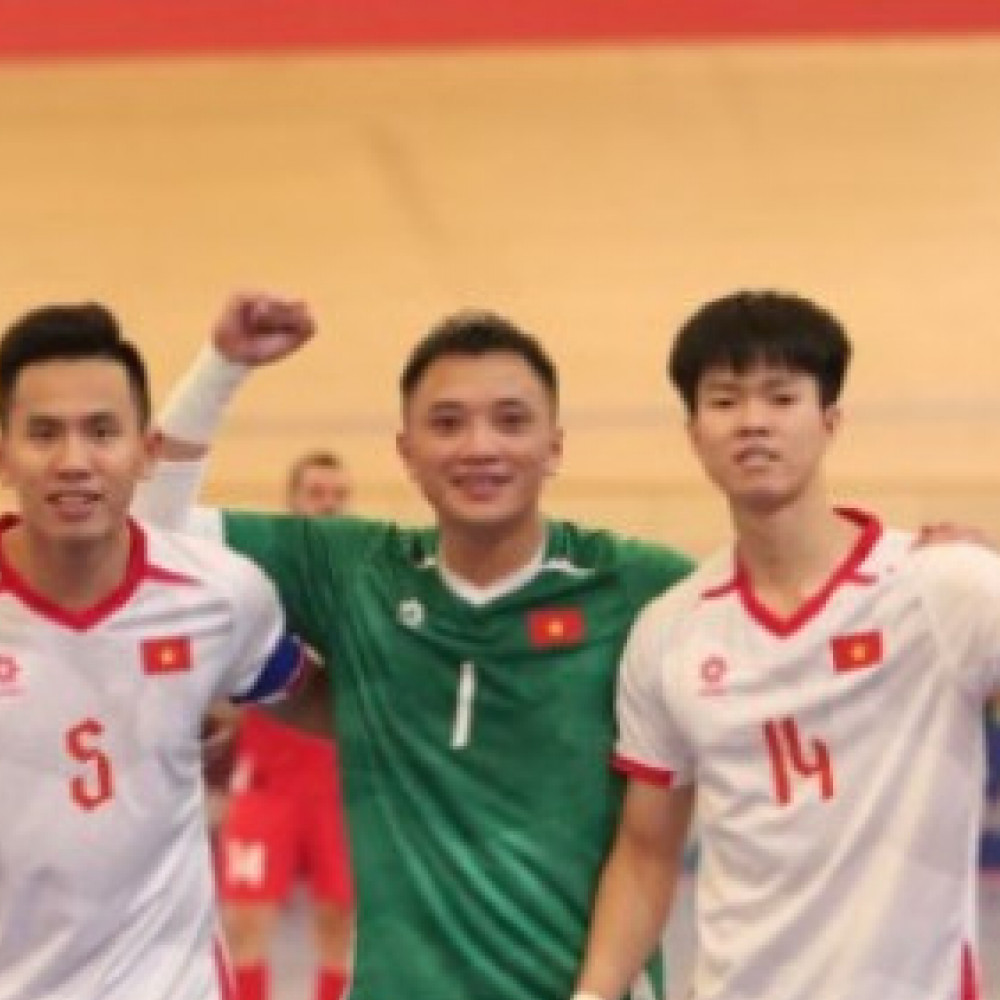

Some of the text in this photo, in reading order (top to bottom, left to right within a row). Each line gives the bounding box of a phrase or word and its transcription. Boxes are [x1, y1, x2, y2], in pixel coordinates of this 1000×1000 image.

[451, 662, 475, 749] 1
[65, 718, 113, 810] 5
[764, 718, 834, 804] 14
